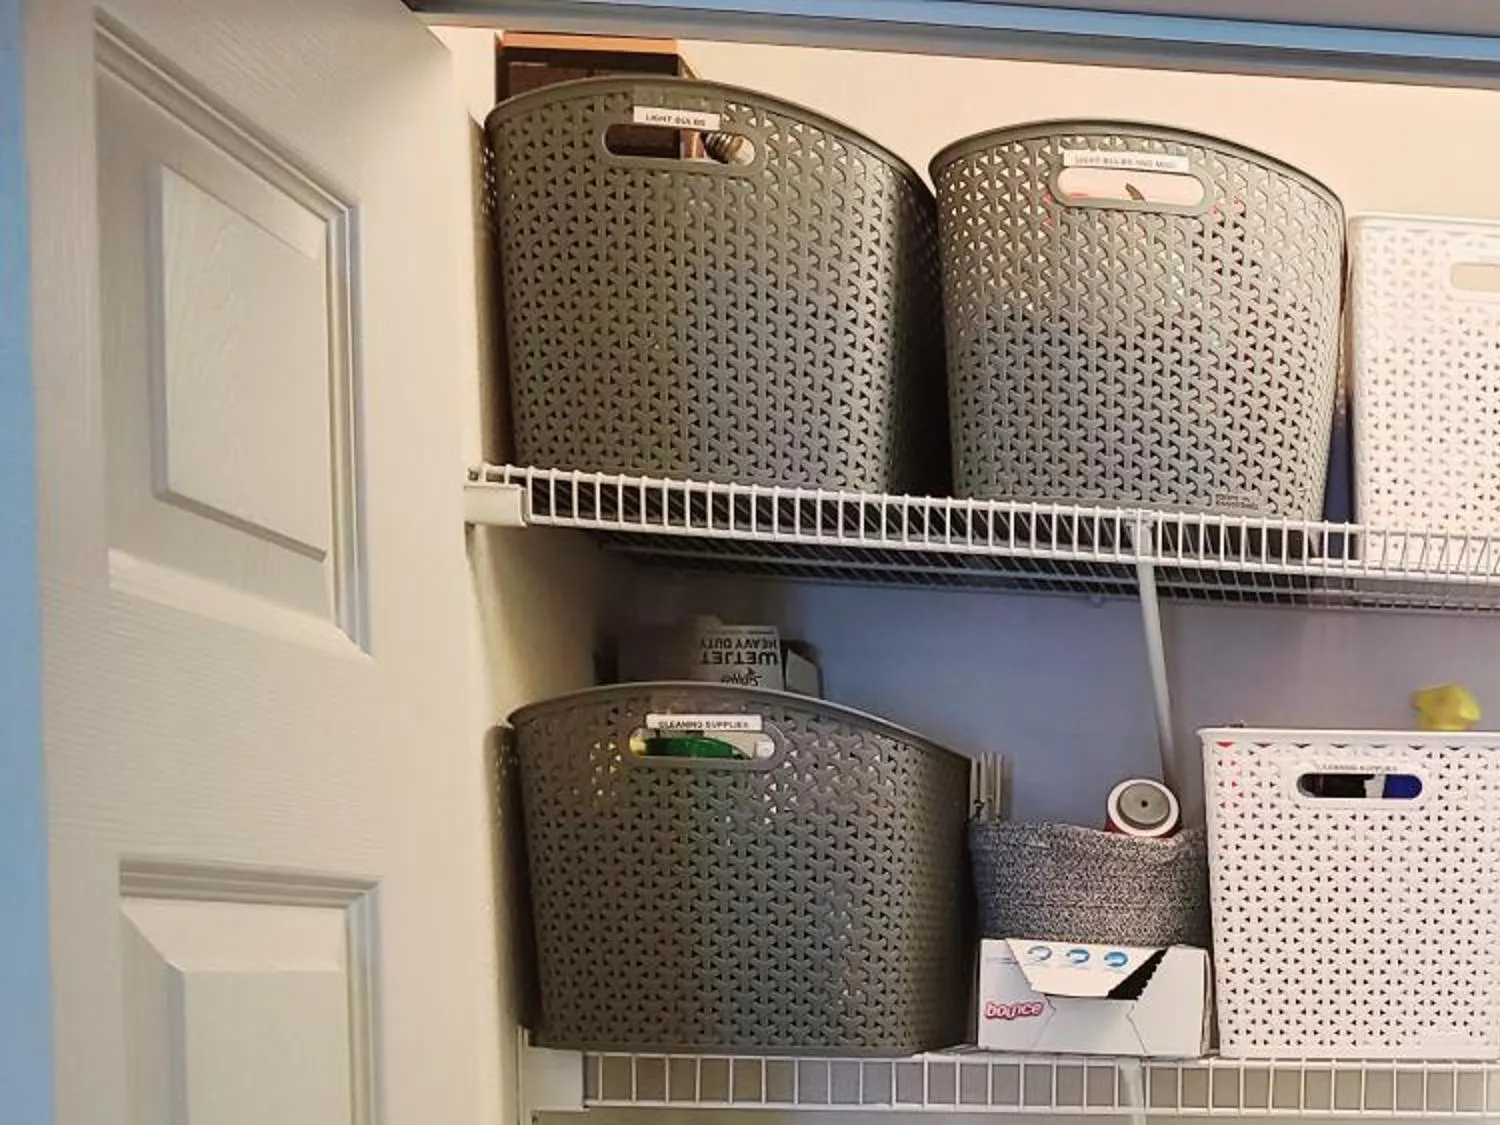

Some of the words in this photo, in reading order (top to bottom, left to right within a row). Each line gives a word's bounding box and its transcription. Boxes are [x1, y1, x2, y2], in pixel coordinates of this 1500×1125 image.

[701, 638, 734, 649] DUTY
[701, 651, 778, 665] WETJET
[658, 720, 703, 729] CLEANING
